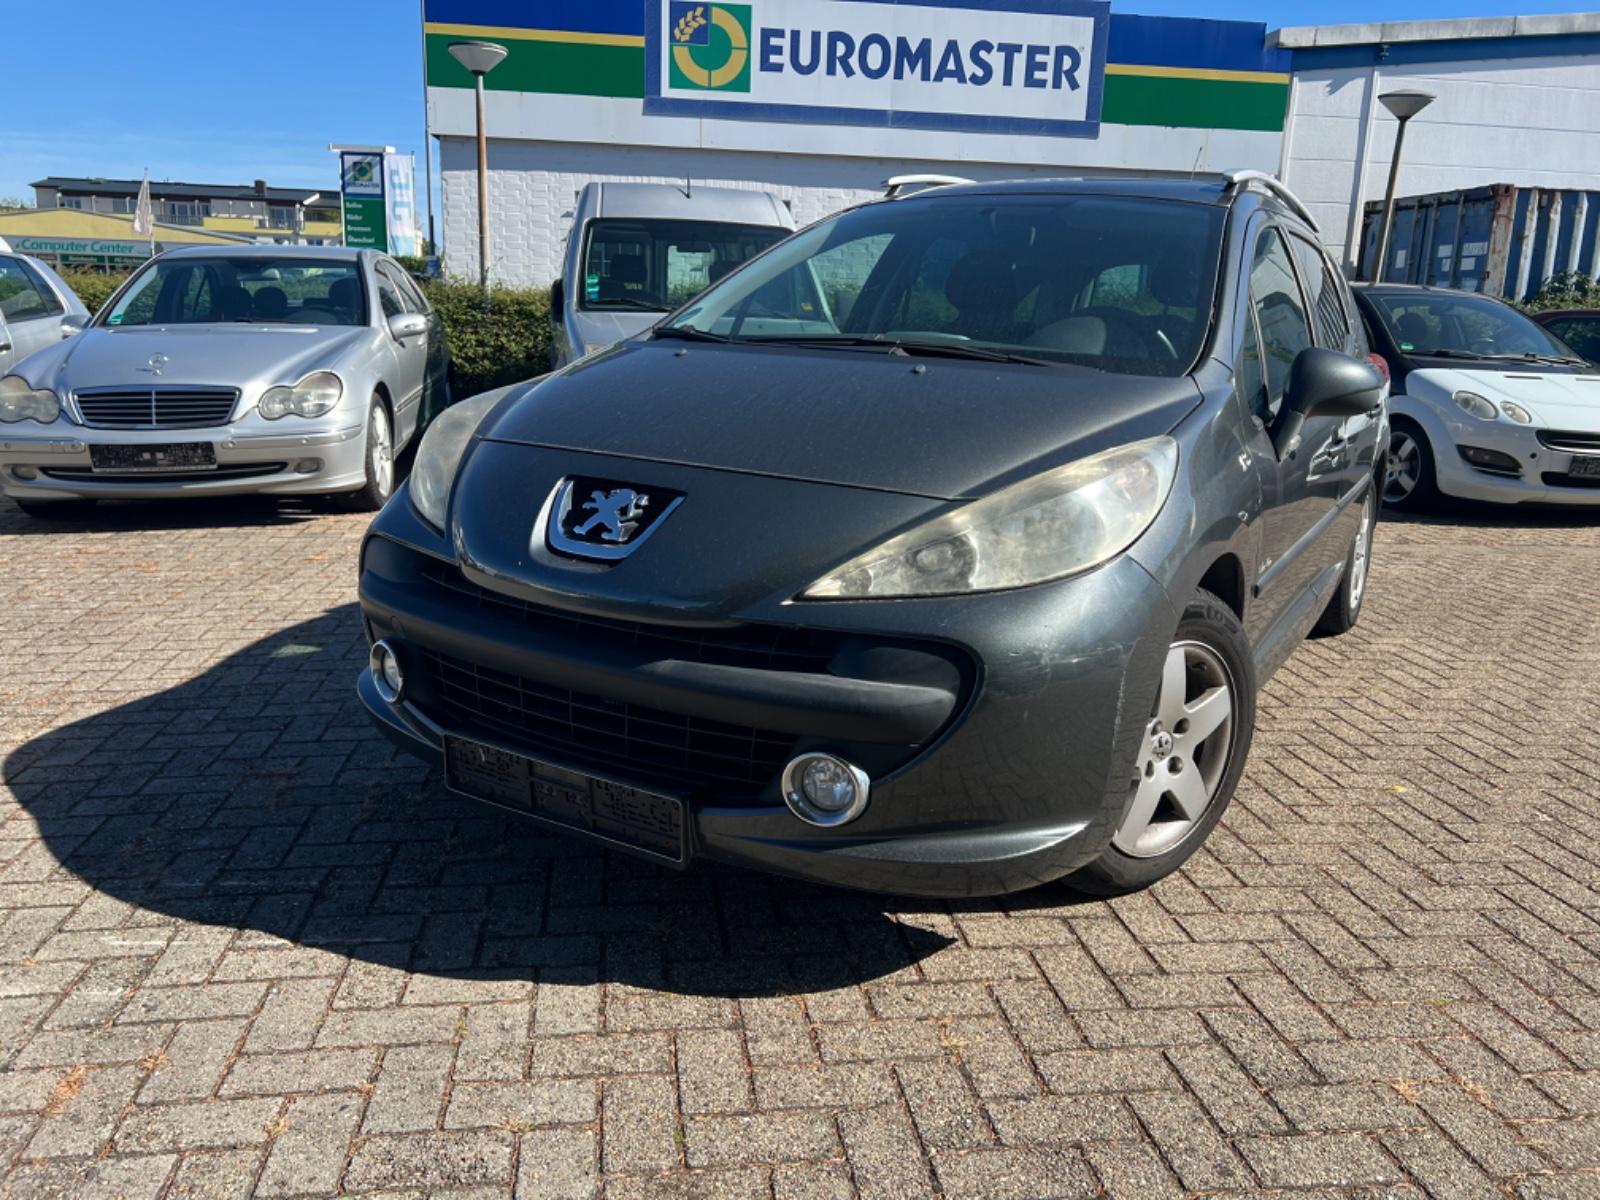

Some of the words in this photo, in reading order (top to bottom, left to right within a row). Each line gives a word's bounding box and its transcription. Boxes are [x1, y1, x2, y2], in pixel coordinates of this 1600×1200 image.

[759, 27, 1081, 91] EUROMASTER
[21, 239, 87, 253] Computer
[90, 241, 134, 253] Center
